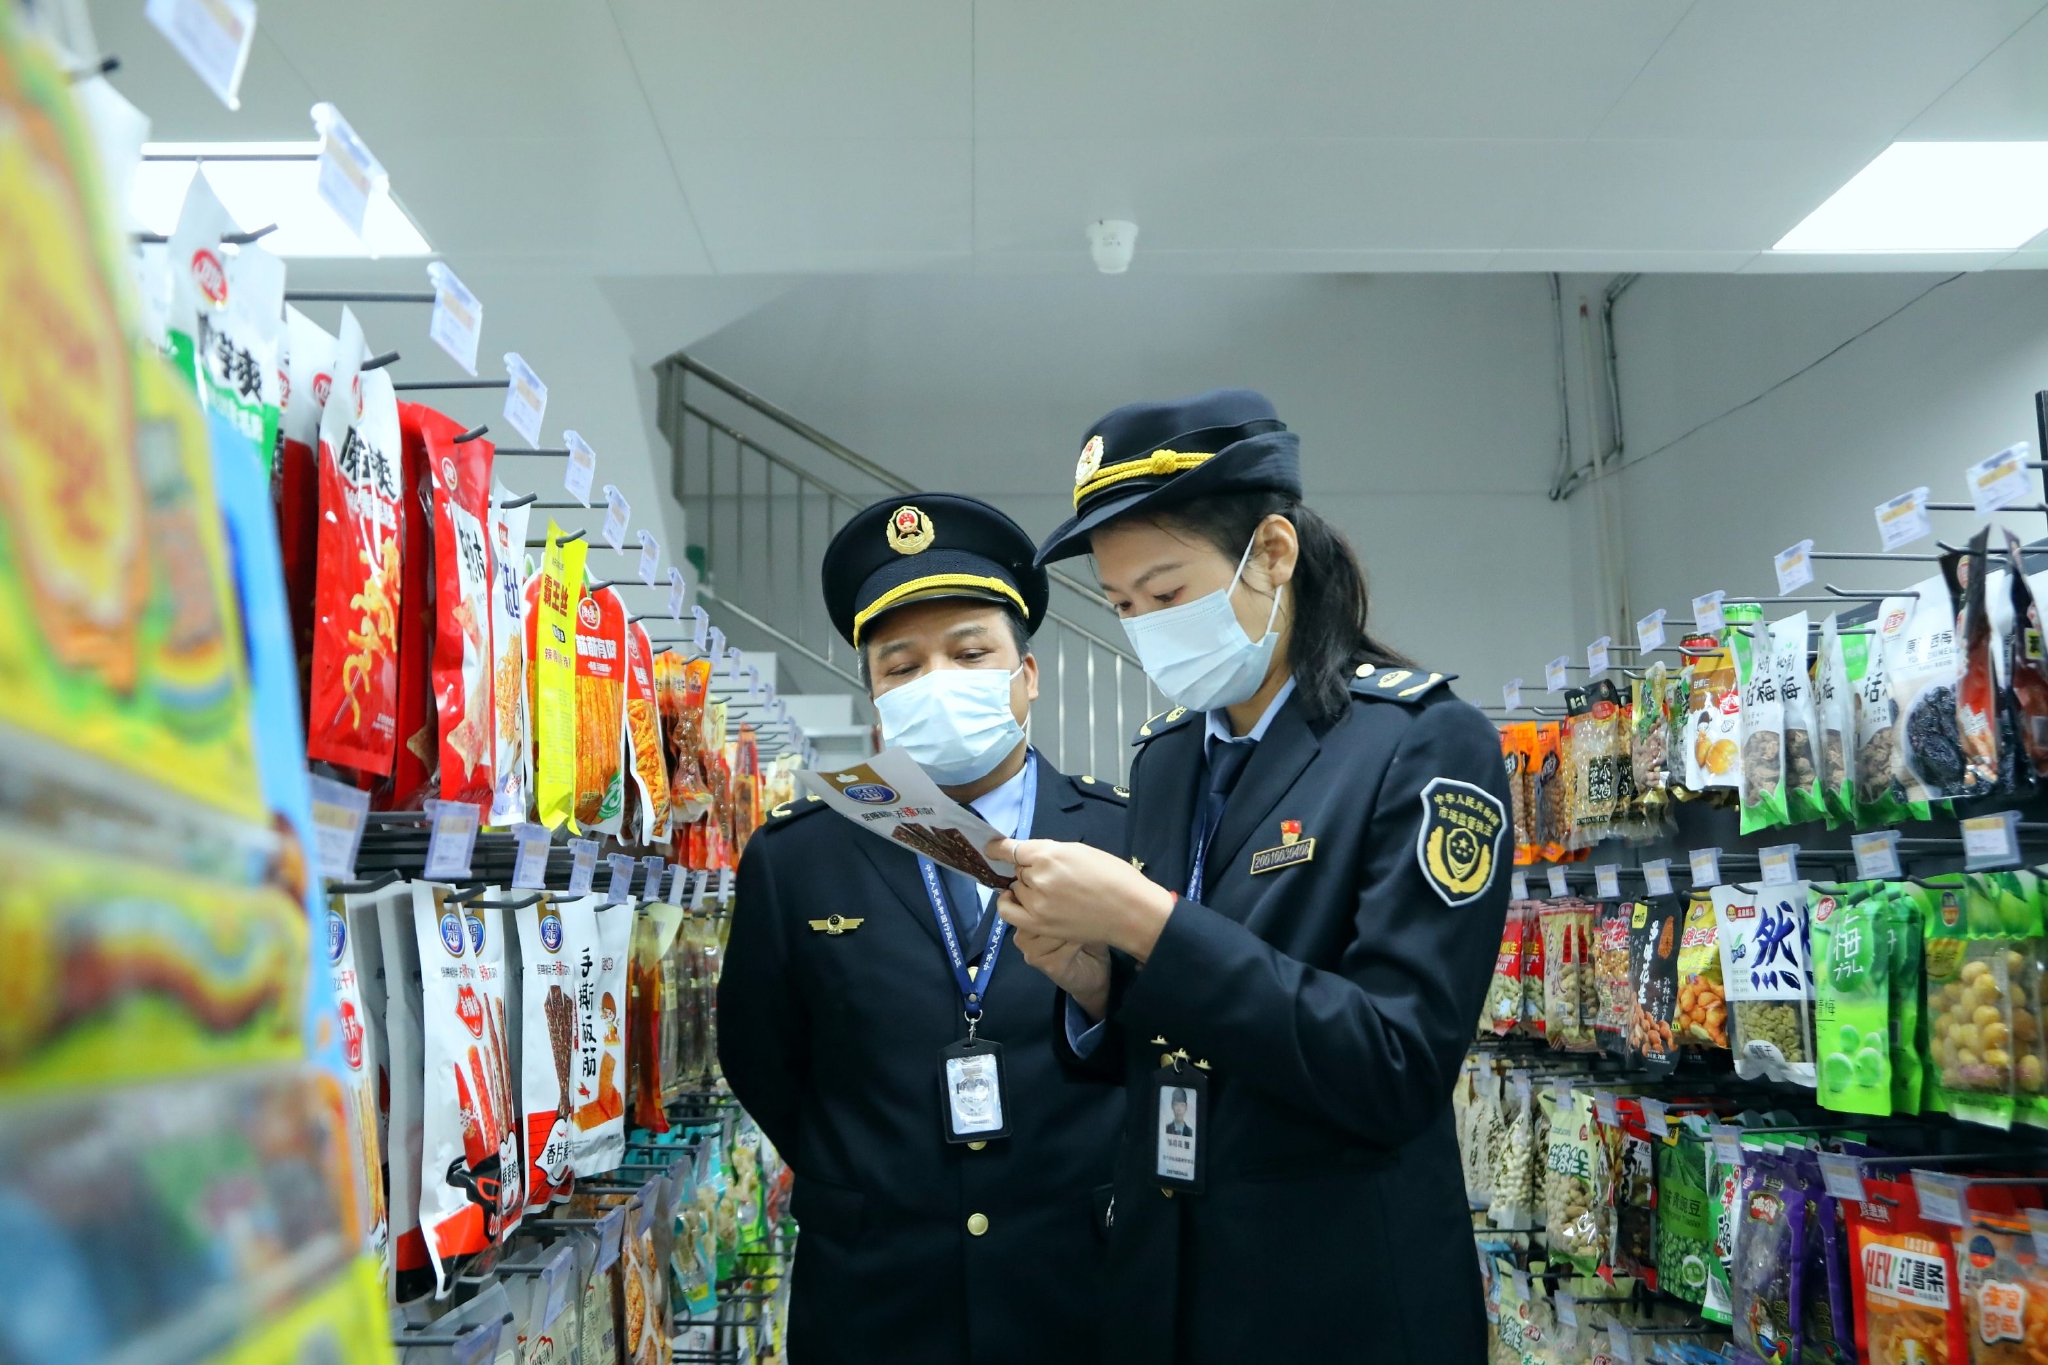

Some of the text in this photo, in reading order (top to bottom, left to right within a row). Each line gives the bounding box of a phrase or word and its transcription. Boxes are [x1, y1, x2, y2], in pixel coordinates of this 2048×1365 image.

[1433, 792, 1500, 827] 中华人民共和国
[1438, 805, 1494, 838] 市场监管执法
[1750, 900, 1802, 992] 然
[1898, 1256, 1945, 1294] 红薯条
